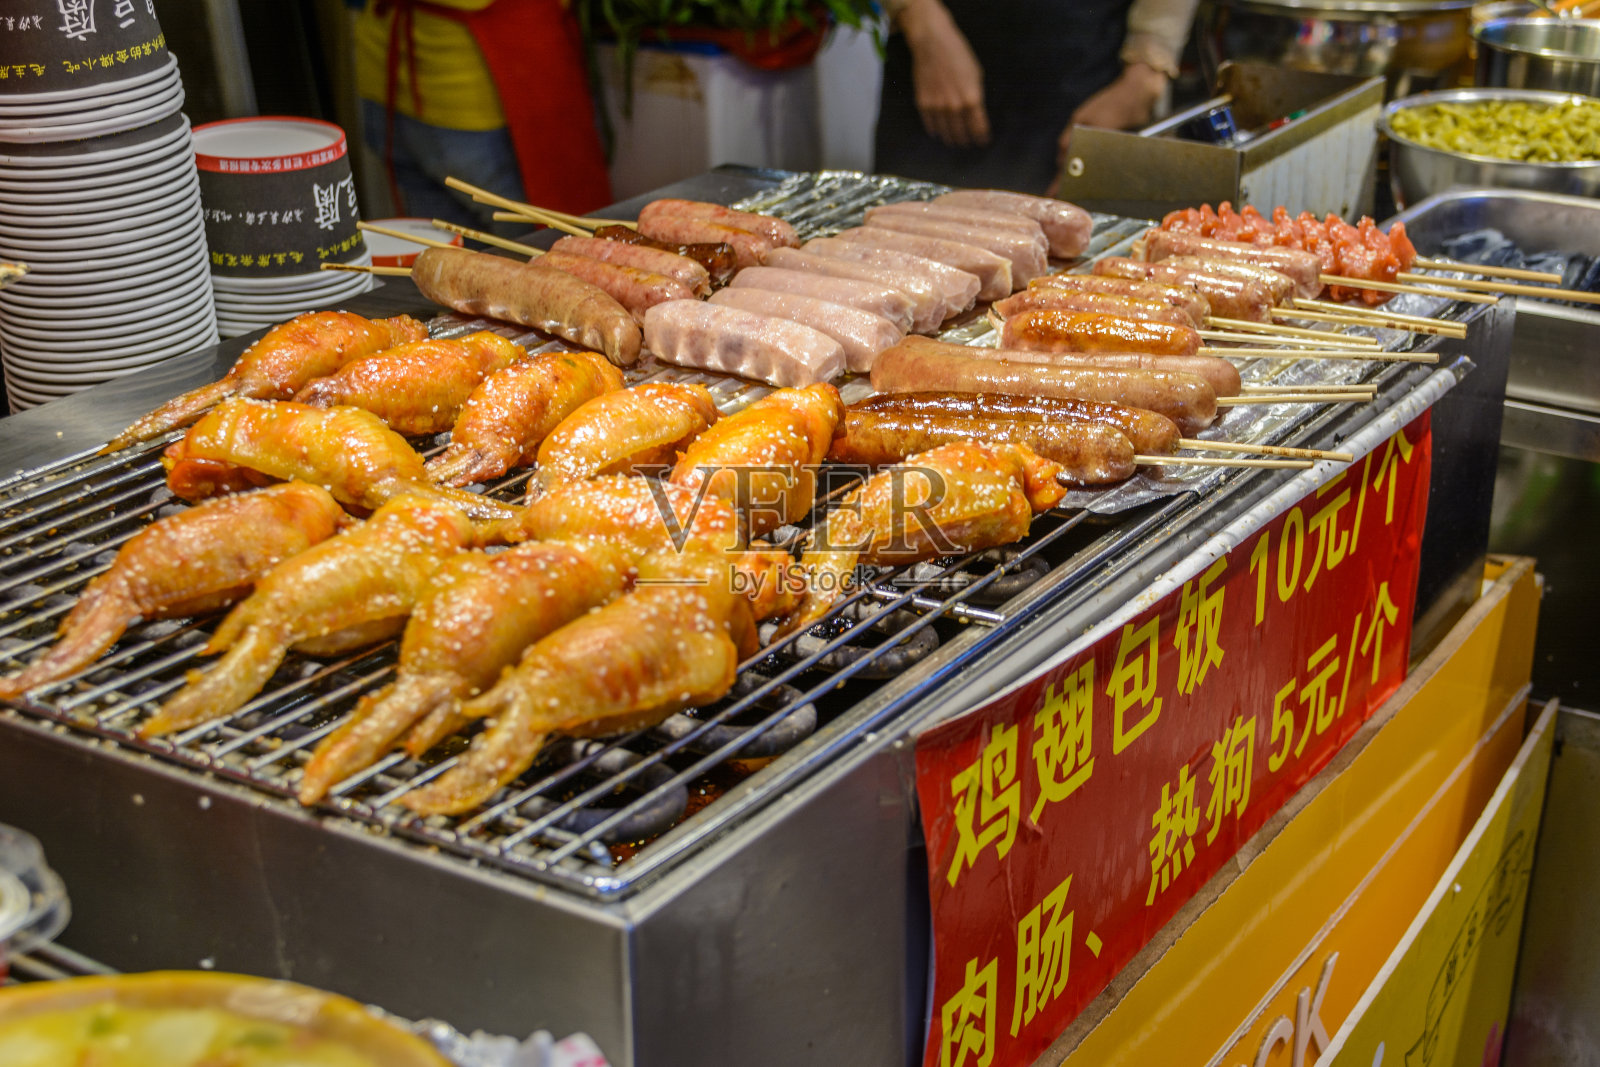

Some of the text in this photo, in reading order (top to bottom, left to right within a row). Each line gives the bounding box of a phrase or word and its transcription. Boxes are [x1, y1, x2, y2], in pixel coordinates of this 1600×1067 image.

[0, 15, 43, 31] 长沙臭
[58, 0, 156, 41] 豆腐
[947, 428, 1415, 888] 鸡翅包饭 10元/个
[1268, 581, 1398, 773] 5元/个
